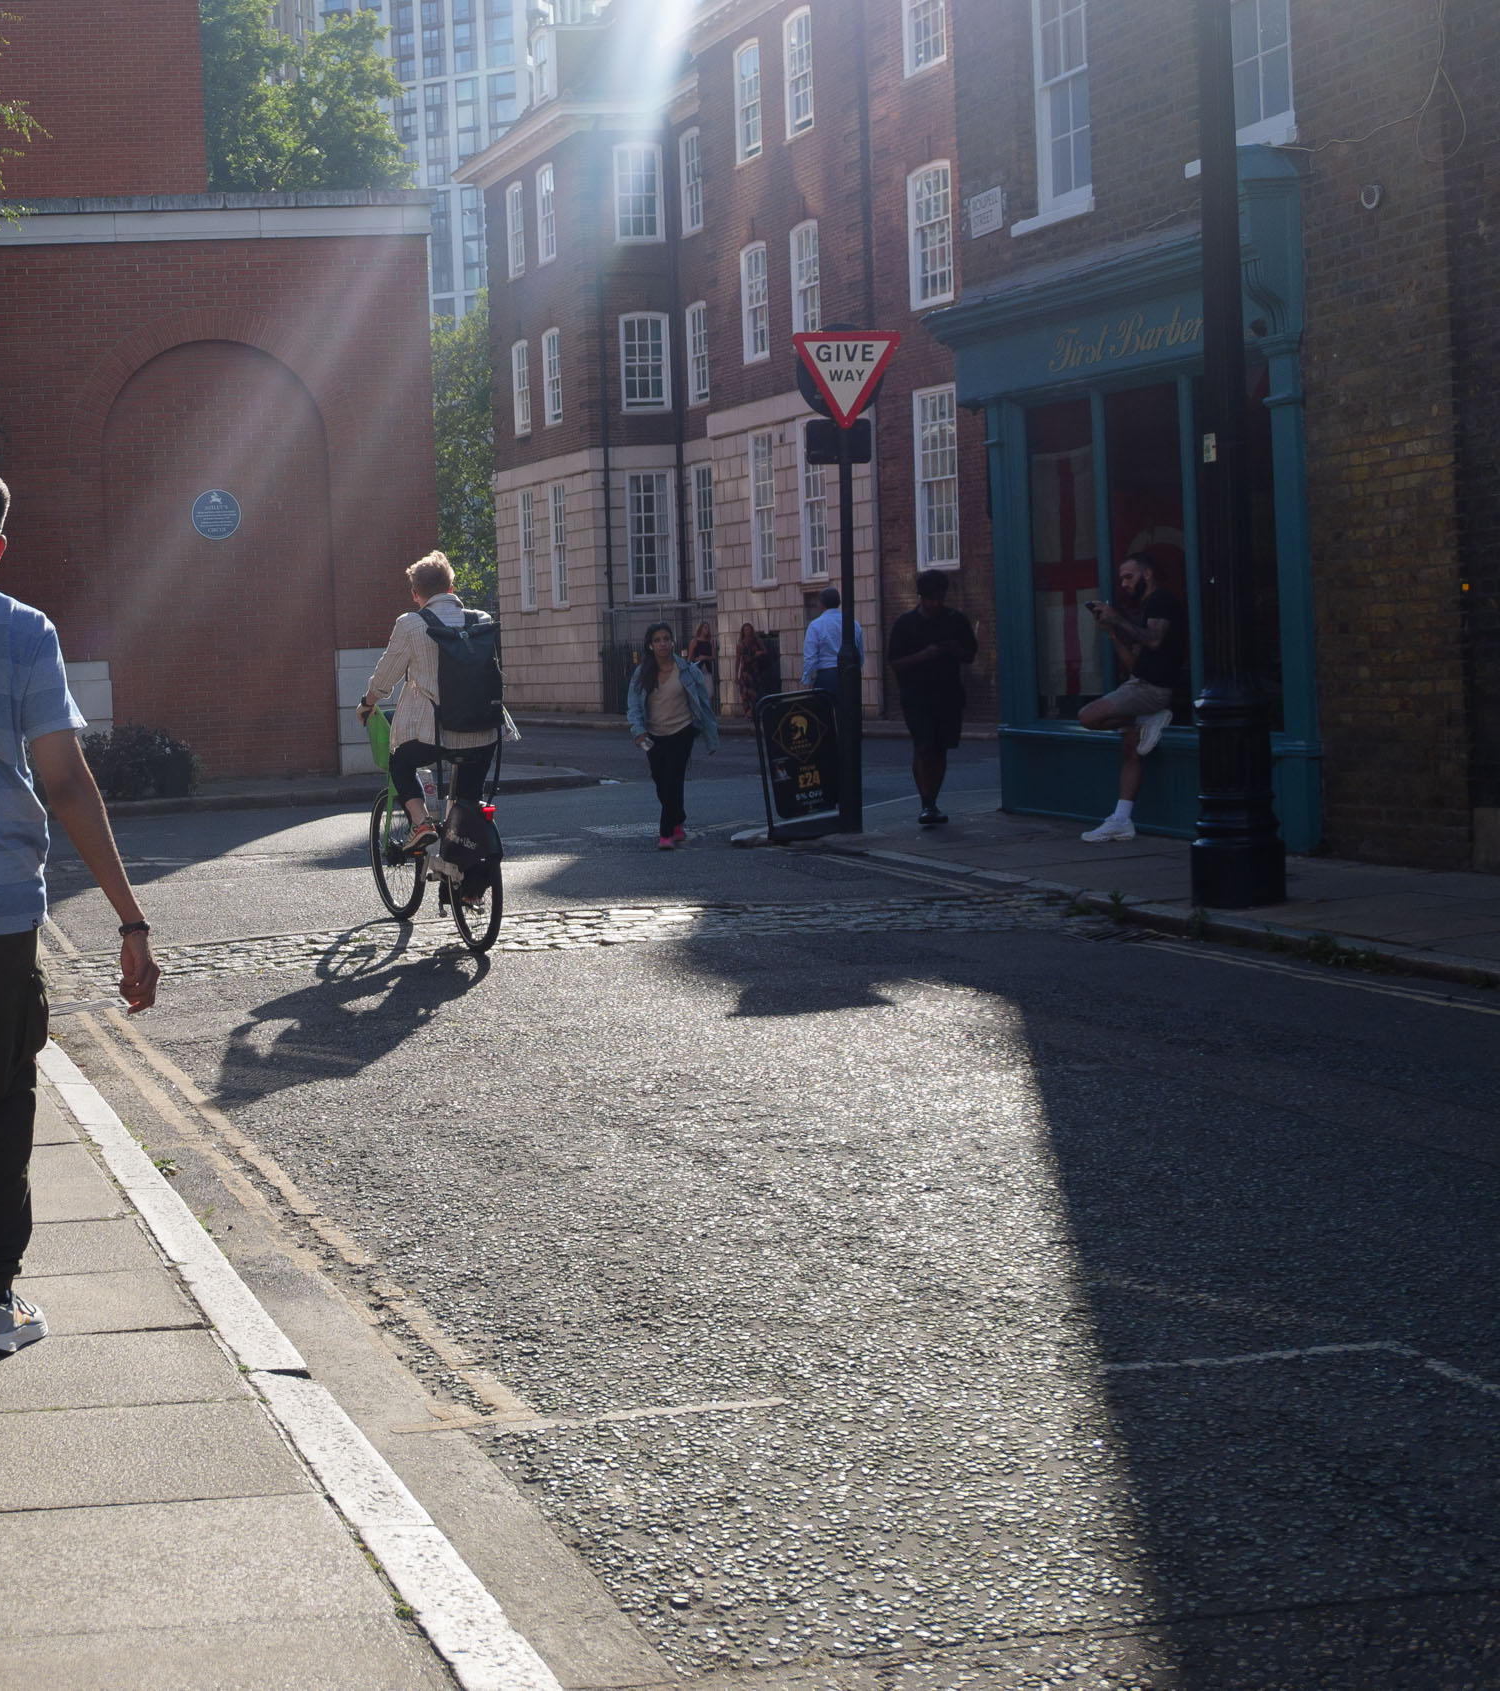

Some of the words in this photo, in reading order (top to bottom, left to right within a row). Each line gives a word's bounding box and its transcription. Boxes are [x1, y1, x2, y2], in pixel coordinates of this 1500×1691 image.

[972, 209, 993, 228] STREET
[816, 344, 875, 362] GIVE
[1048, 324, 1108, 372] First
[829, 369, 865, 382] WAY
[463, 836, 476, 850] Uber
